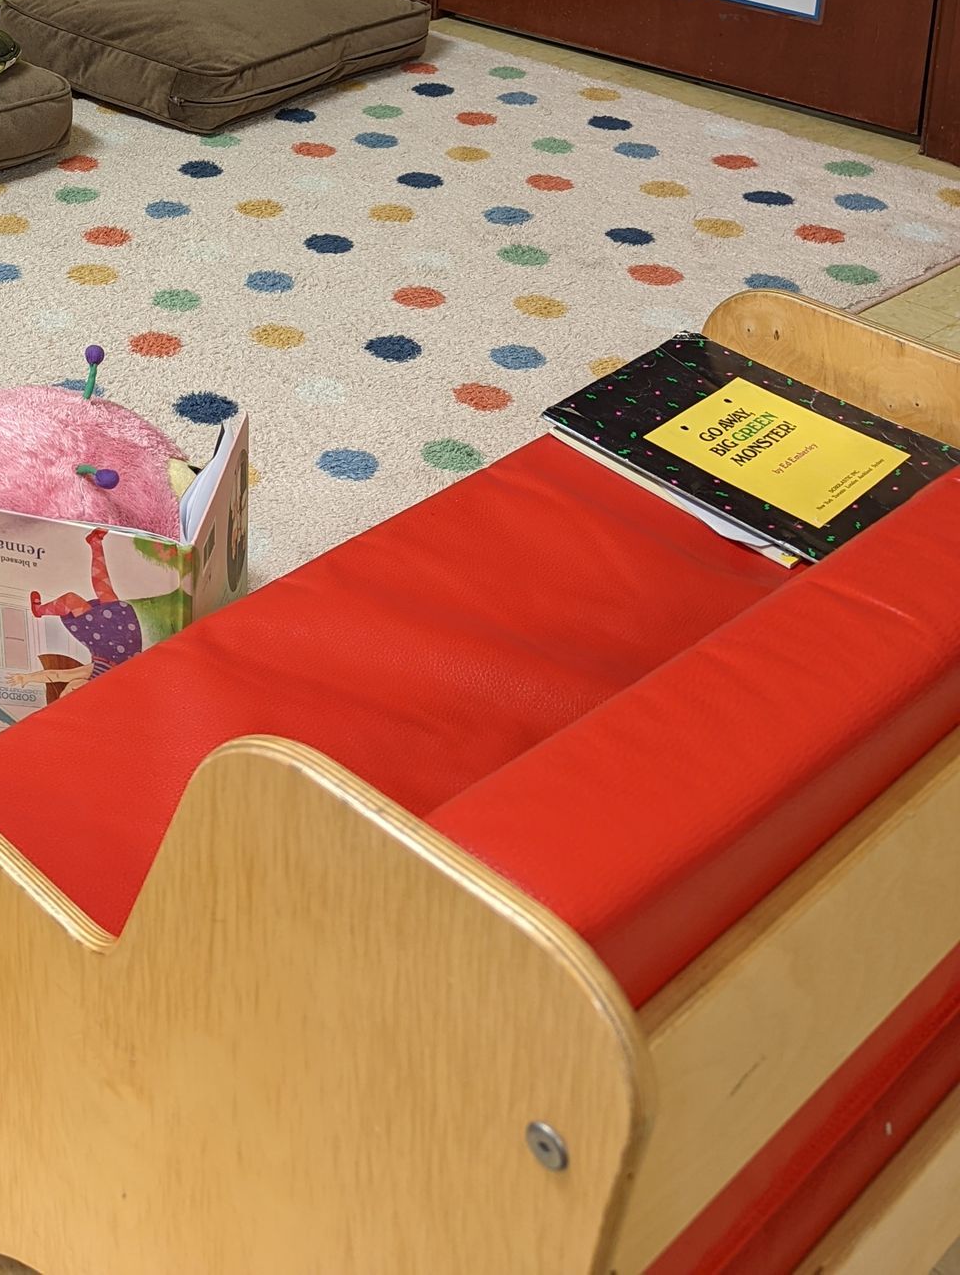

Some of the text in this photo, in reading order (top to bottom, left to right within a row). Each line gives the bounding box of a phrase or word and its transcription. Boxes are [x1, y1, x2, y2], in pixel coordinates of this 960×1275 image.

[698, 407, 756, 442] GO AWAY,
[709, 411, 778, 457] BIG GREEN
[730, 420, 797, 467] MONSTER!
[772, 443, 818, 474] by Ed Emberley
[0, 555, 30, 568] blessed
